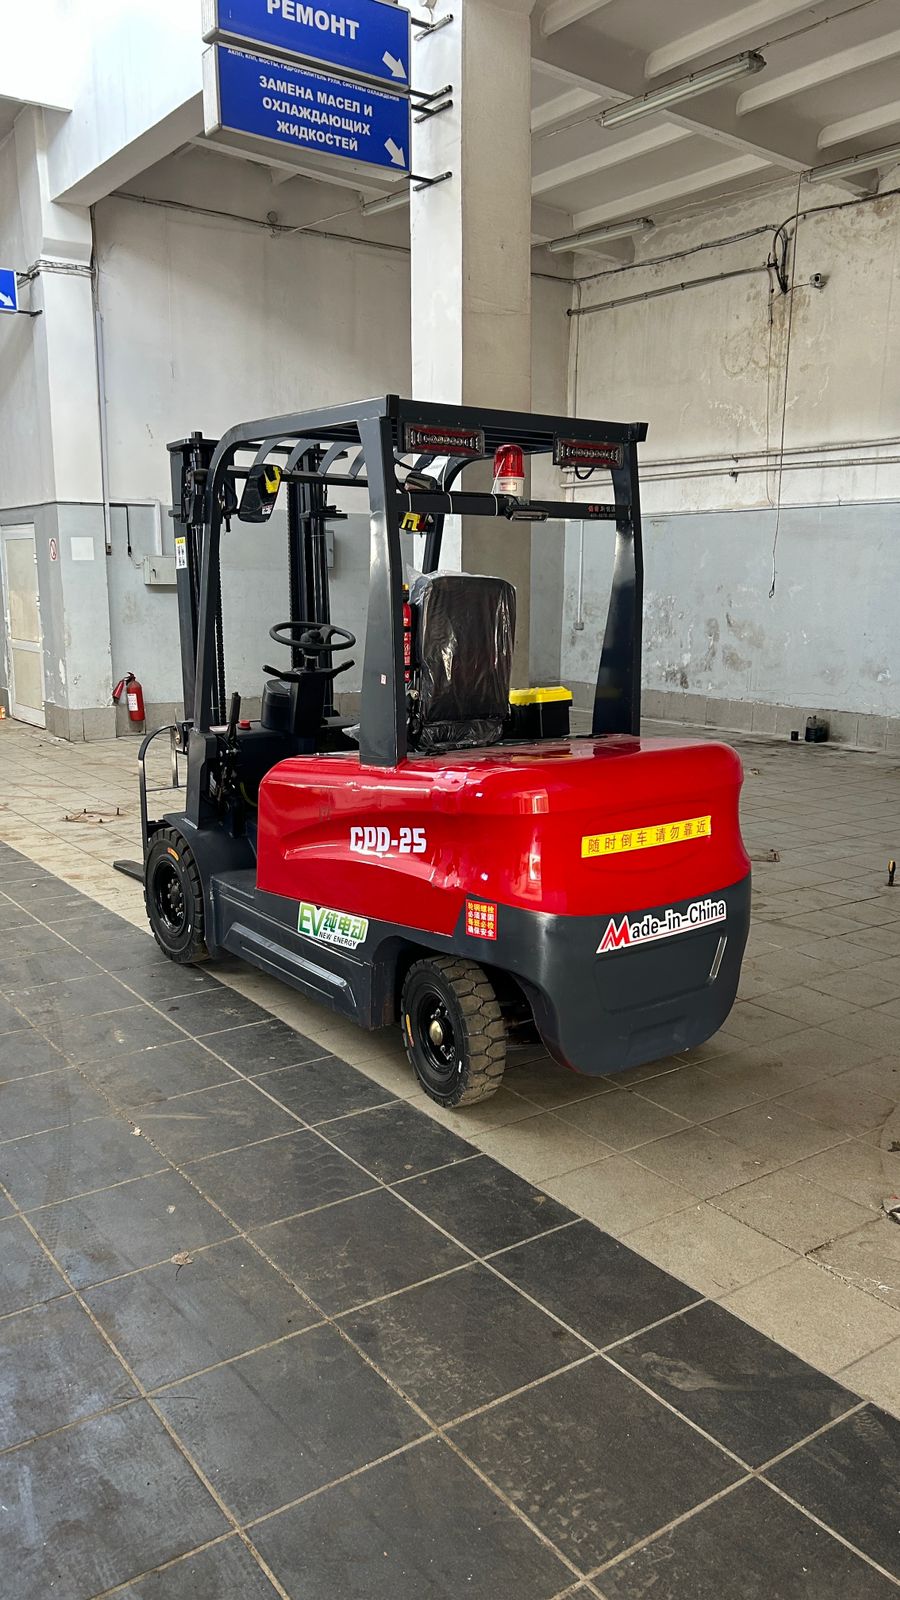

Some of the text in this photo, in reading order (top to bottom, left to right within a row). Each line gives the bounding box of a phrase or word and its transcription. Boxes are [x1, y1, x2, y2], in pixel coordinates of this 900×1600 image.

[267, 0, 360, 40] РЕМОНТ
[259, 75, 373, 117] ЗАМЕНА МАСЕЛ И
[262, 96, 371, 136] ОХЛАЖДАЮЩИХ
[276, 120, 358, 152] ЖИДКОСТЕЙ
[350, 826, 427, 854] CPD-25
[319, 932, 357, 948] NEW ENERGY
